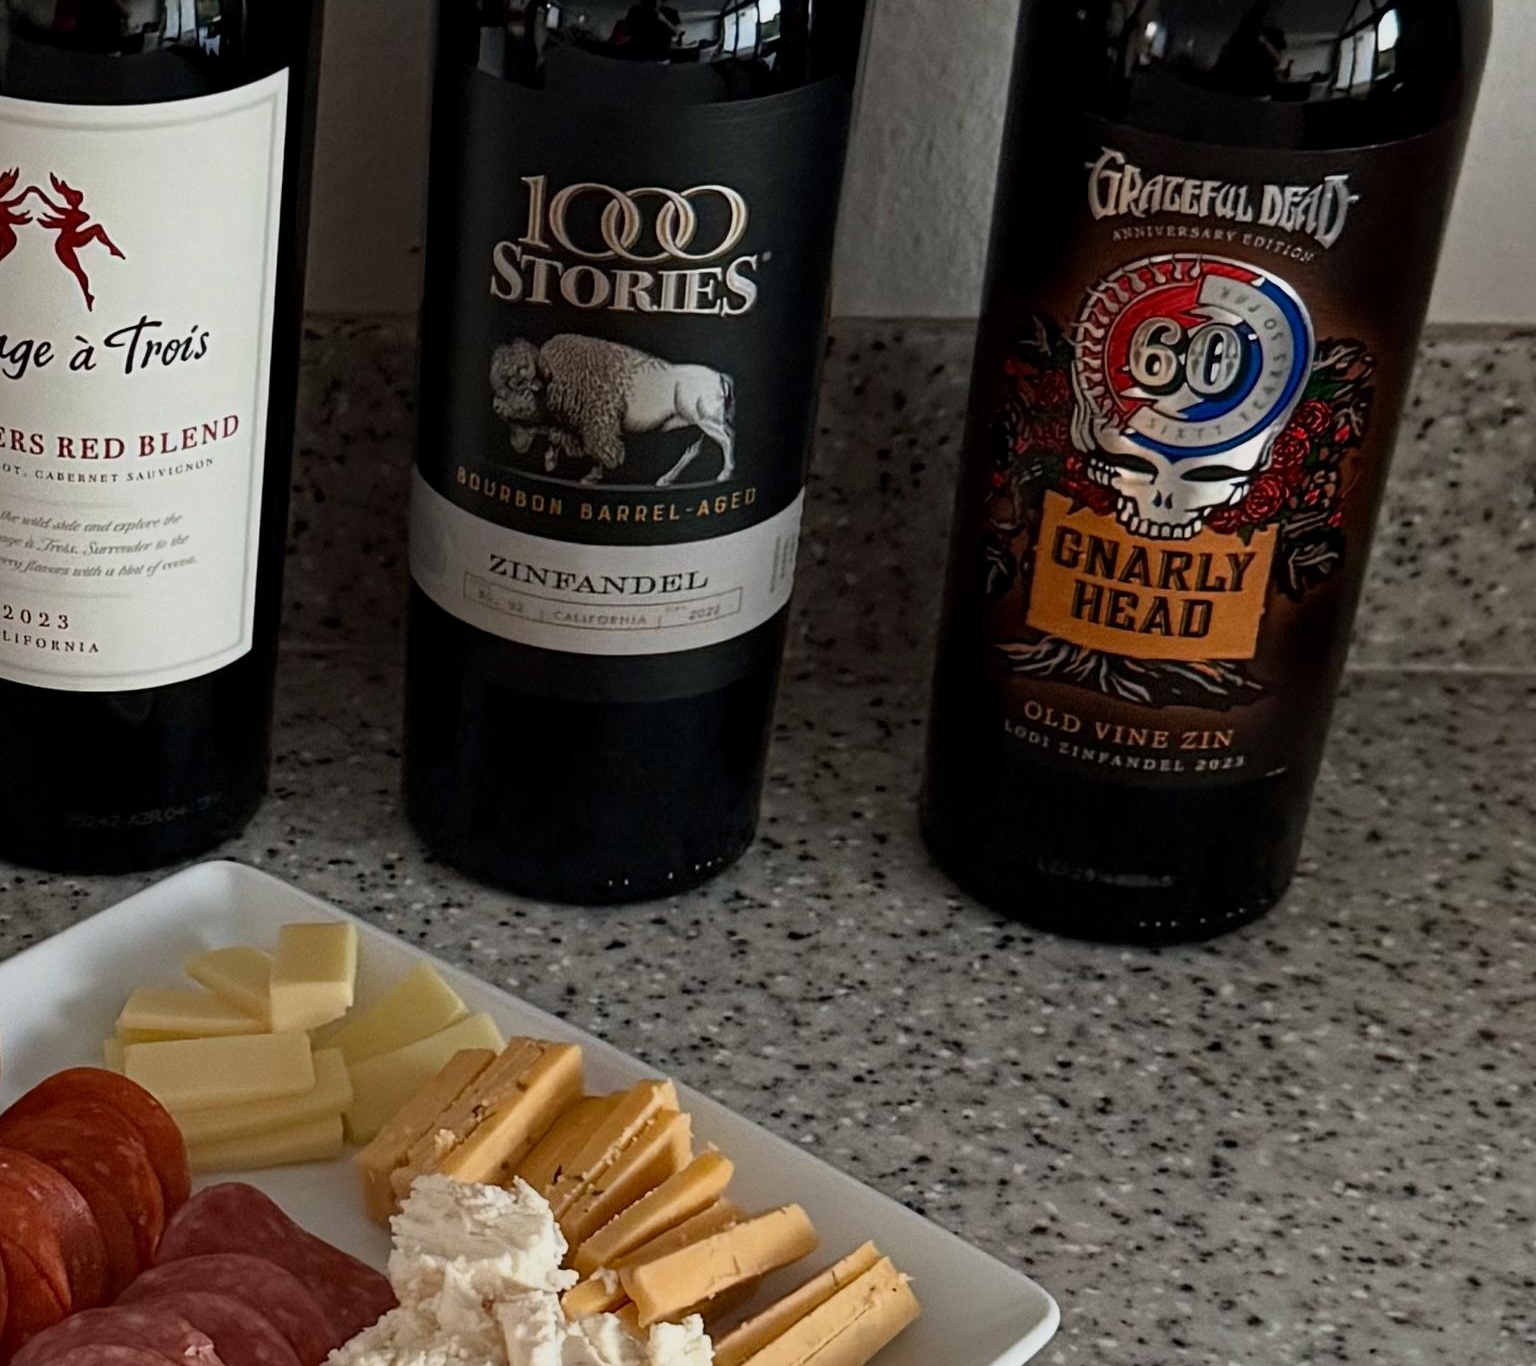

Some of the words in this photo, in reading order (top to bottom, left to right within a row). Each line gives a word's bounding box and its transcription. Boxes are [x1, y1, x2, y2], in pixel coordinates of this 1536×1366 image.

[517, 174, 749, 262] 1000
[1084, 146, 1253, 223] GRATEFUL
[1258, 174, 1360, 250] DEAD
[1113, 225, 1238, 242] ANNIVERSARY
[1242, 233, 1314, 264] EDITION
[489, 240, 759, 317] STORIES
[69, 336, 96, 372] à
[103, 315, 210, 375] Trois
[1129, 317, 1243, 395] 60
[57, 436, 125, 460] RED
[138, 413, 239, 458] BLEND
[35, 469, 119, 484] CABERNET
[126, 457, 214, 482] SAUVIGNON
[455, 465, 564, 518] BOURBON
[578, 486, 758, 522] BARREL-AGED
[0, 507, 20, 522] the
[22, 515, 52, 529] wild
[83, 520, 111, 533] and
[113, 517, 161, 535] explore
[163, 512, 183, 526] the
[72, 564, 101, 578] with
[105, 568, 114, 577] a
[83, 539, 152, 556] Surrender
[1049, 524, 1257, 597] GNARLY
[489, 553, 710, 596] ZINFANDEL
[2, 603, 71, 631] 2023
[552, 609, 648, 626] CALIFORNIA
[1071, 578, 1215, 640] HEAD
[1004, 718, 1050, 748] LODI
[1058, 742, 1186, 772] ZINFANDEL
[1194, 756, 1246, 772] 2023
[1023, 700, 1082, 733] OLD
[1094, 722, 1170, 749] VINE
[1179, 729, 1235, 750] ZIN
